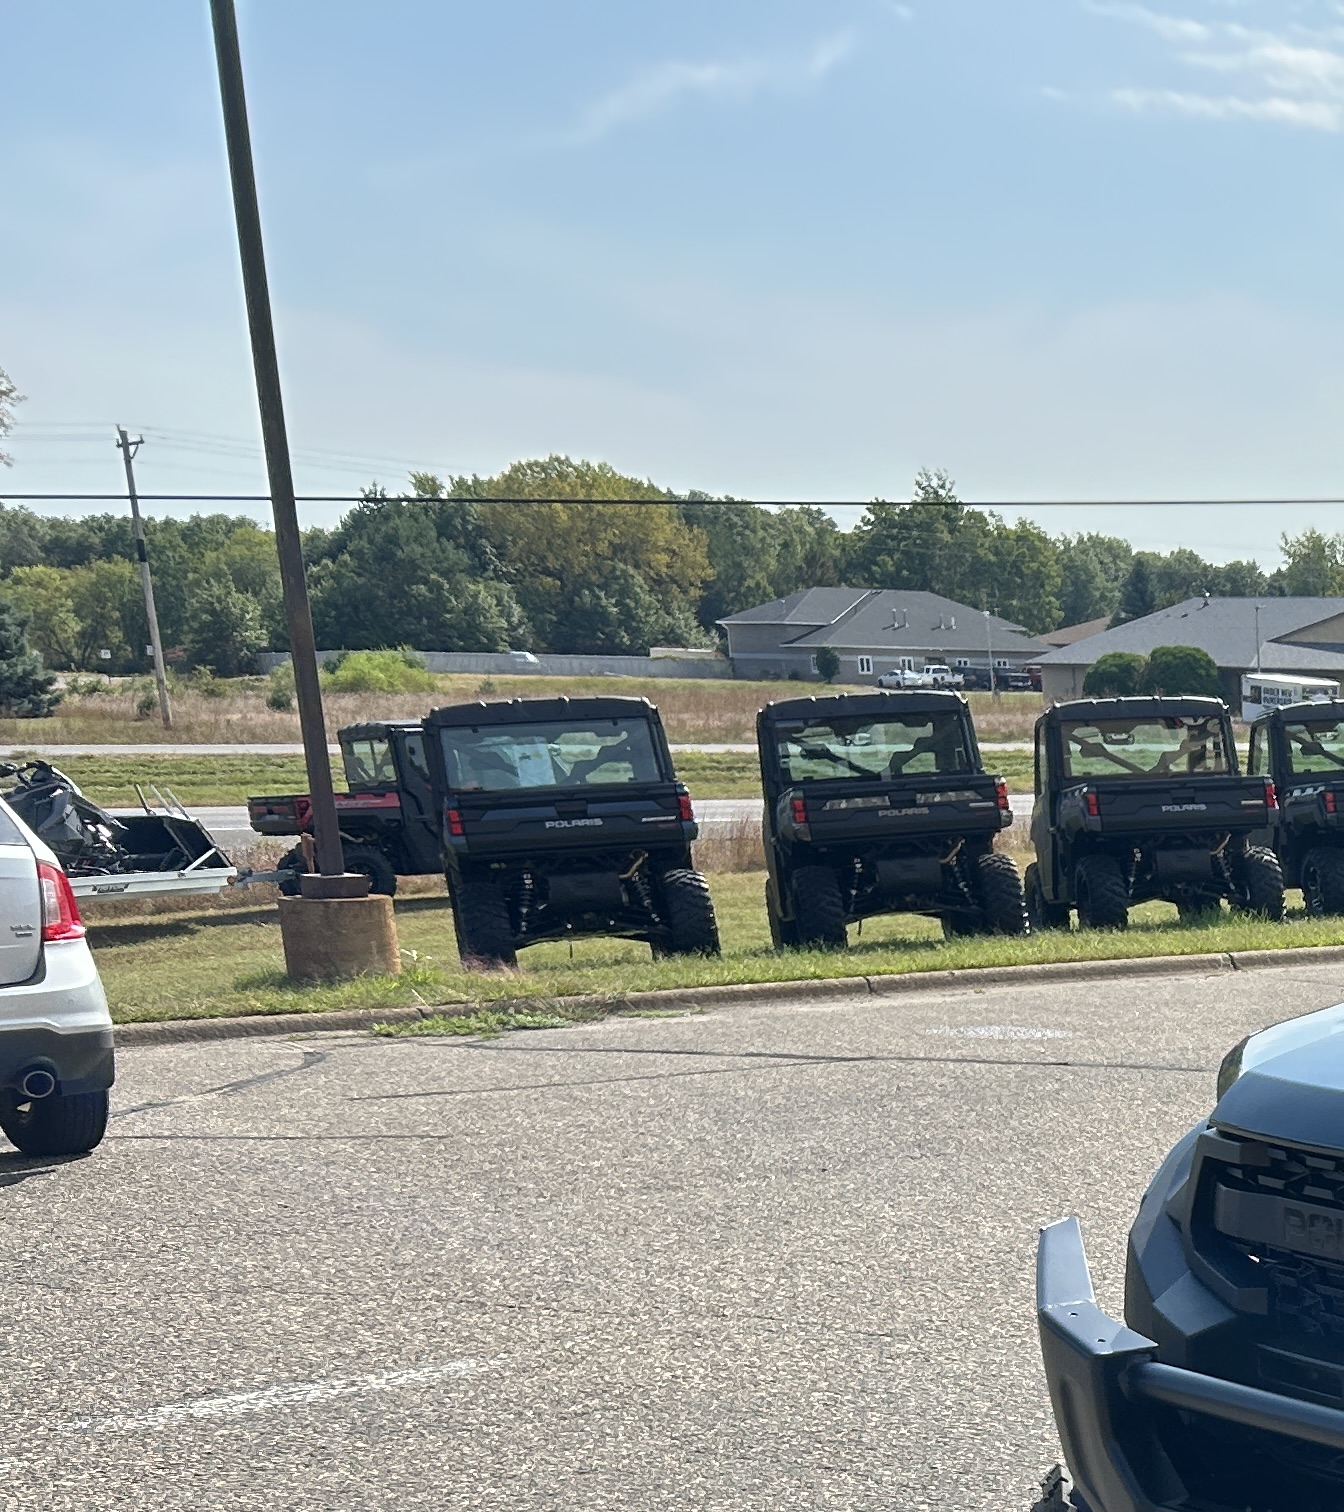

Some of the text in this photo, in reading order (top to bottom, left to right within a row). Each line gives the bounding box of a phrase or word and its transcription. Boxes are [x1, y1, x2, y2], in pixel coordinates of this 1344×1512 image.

[878, 806, 930, 817] POLARIS
[1161, 803, 1207, 812] POLARIS
[545, 817, 604, 829] POLARIS
